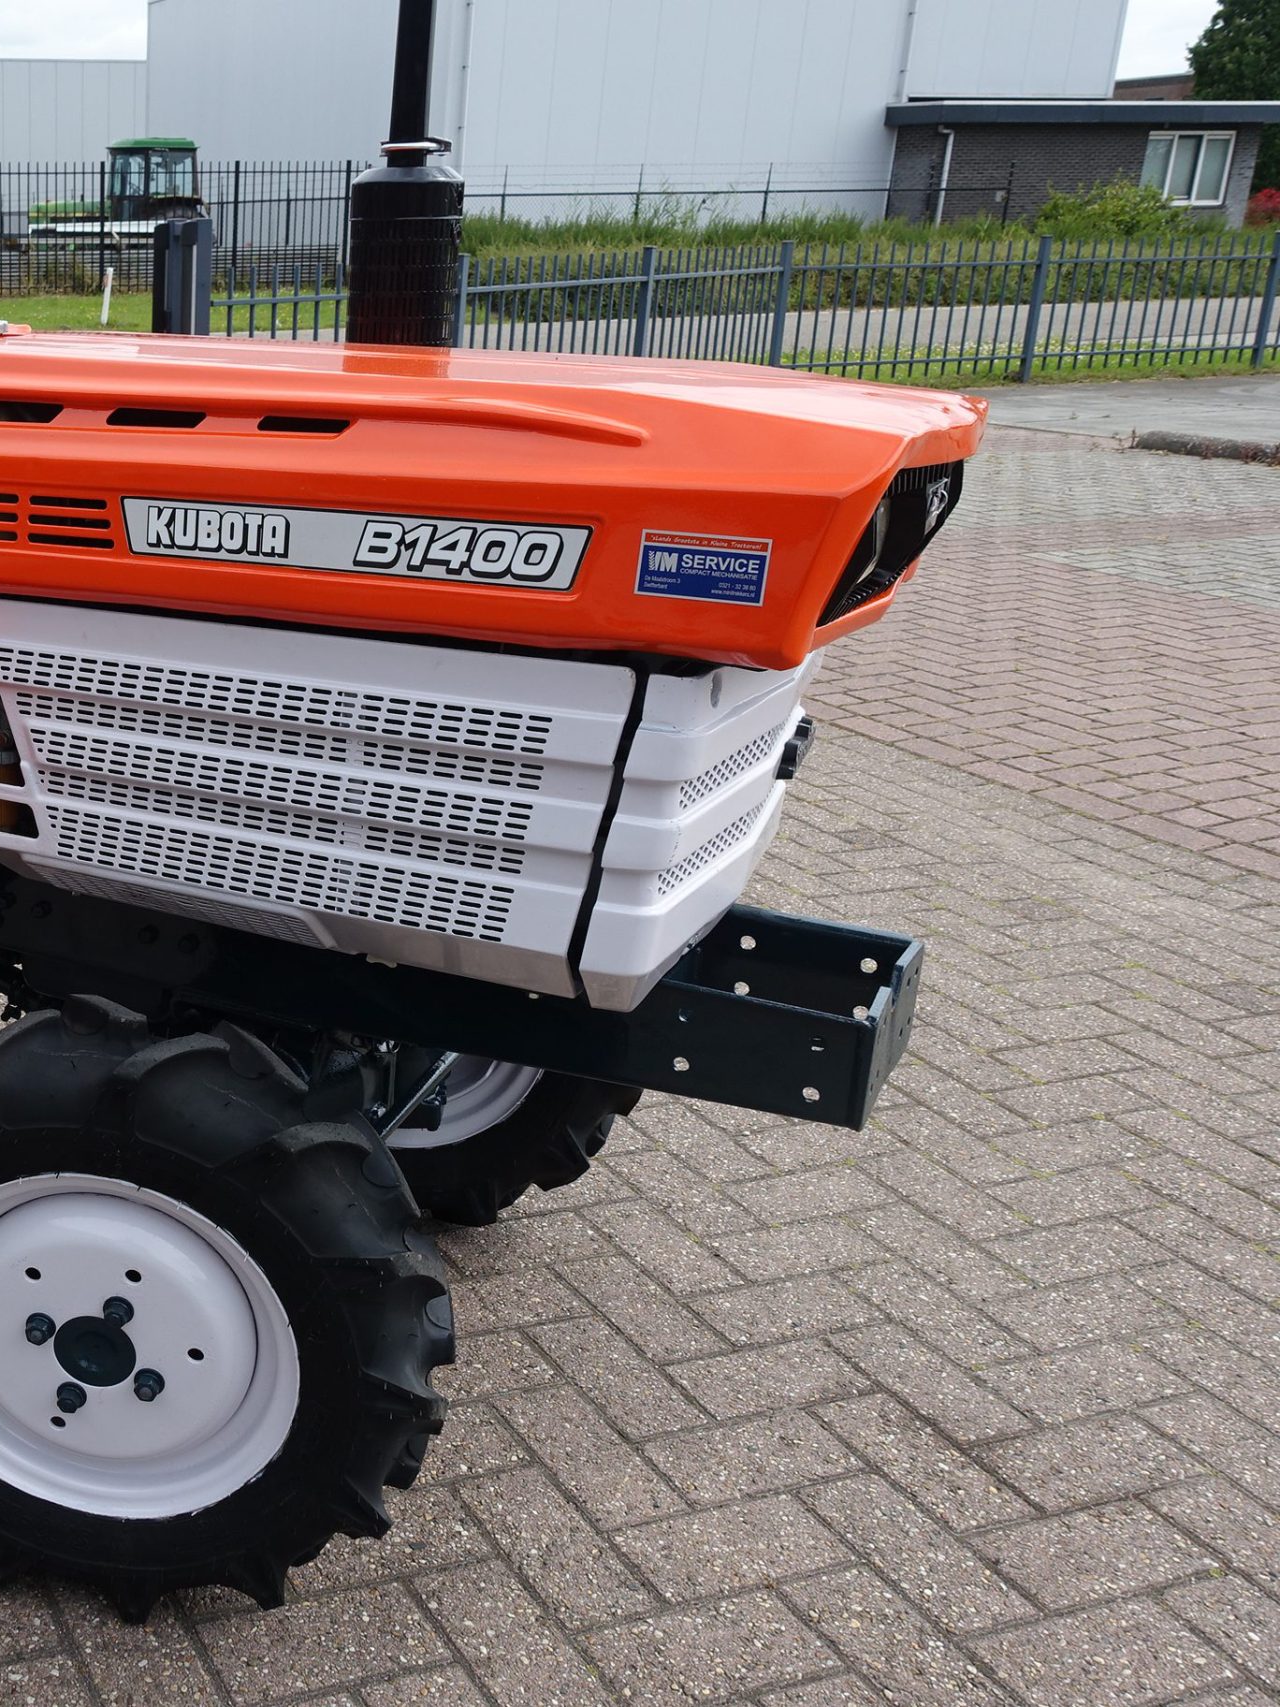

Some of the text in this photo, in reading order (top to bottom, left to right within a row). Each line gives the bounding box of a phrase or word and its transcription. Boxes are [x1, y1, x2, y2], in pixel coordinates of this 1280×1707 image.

[146, 505, 565, 582] KUBOTA B1400
[681, 554, 760, 574] SERVICE
[680, 568, 758, 581] COMPACT MECHANISATIE
